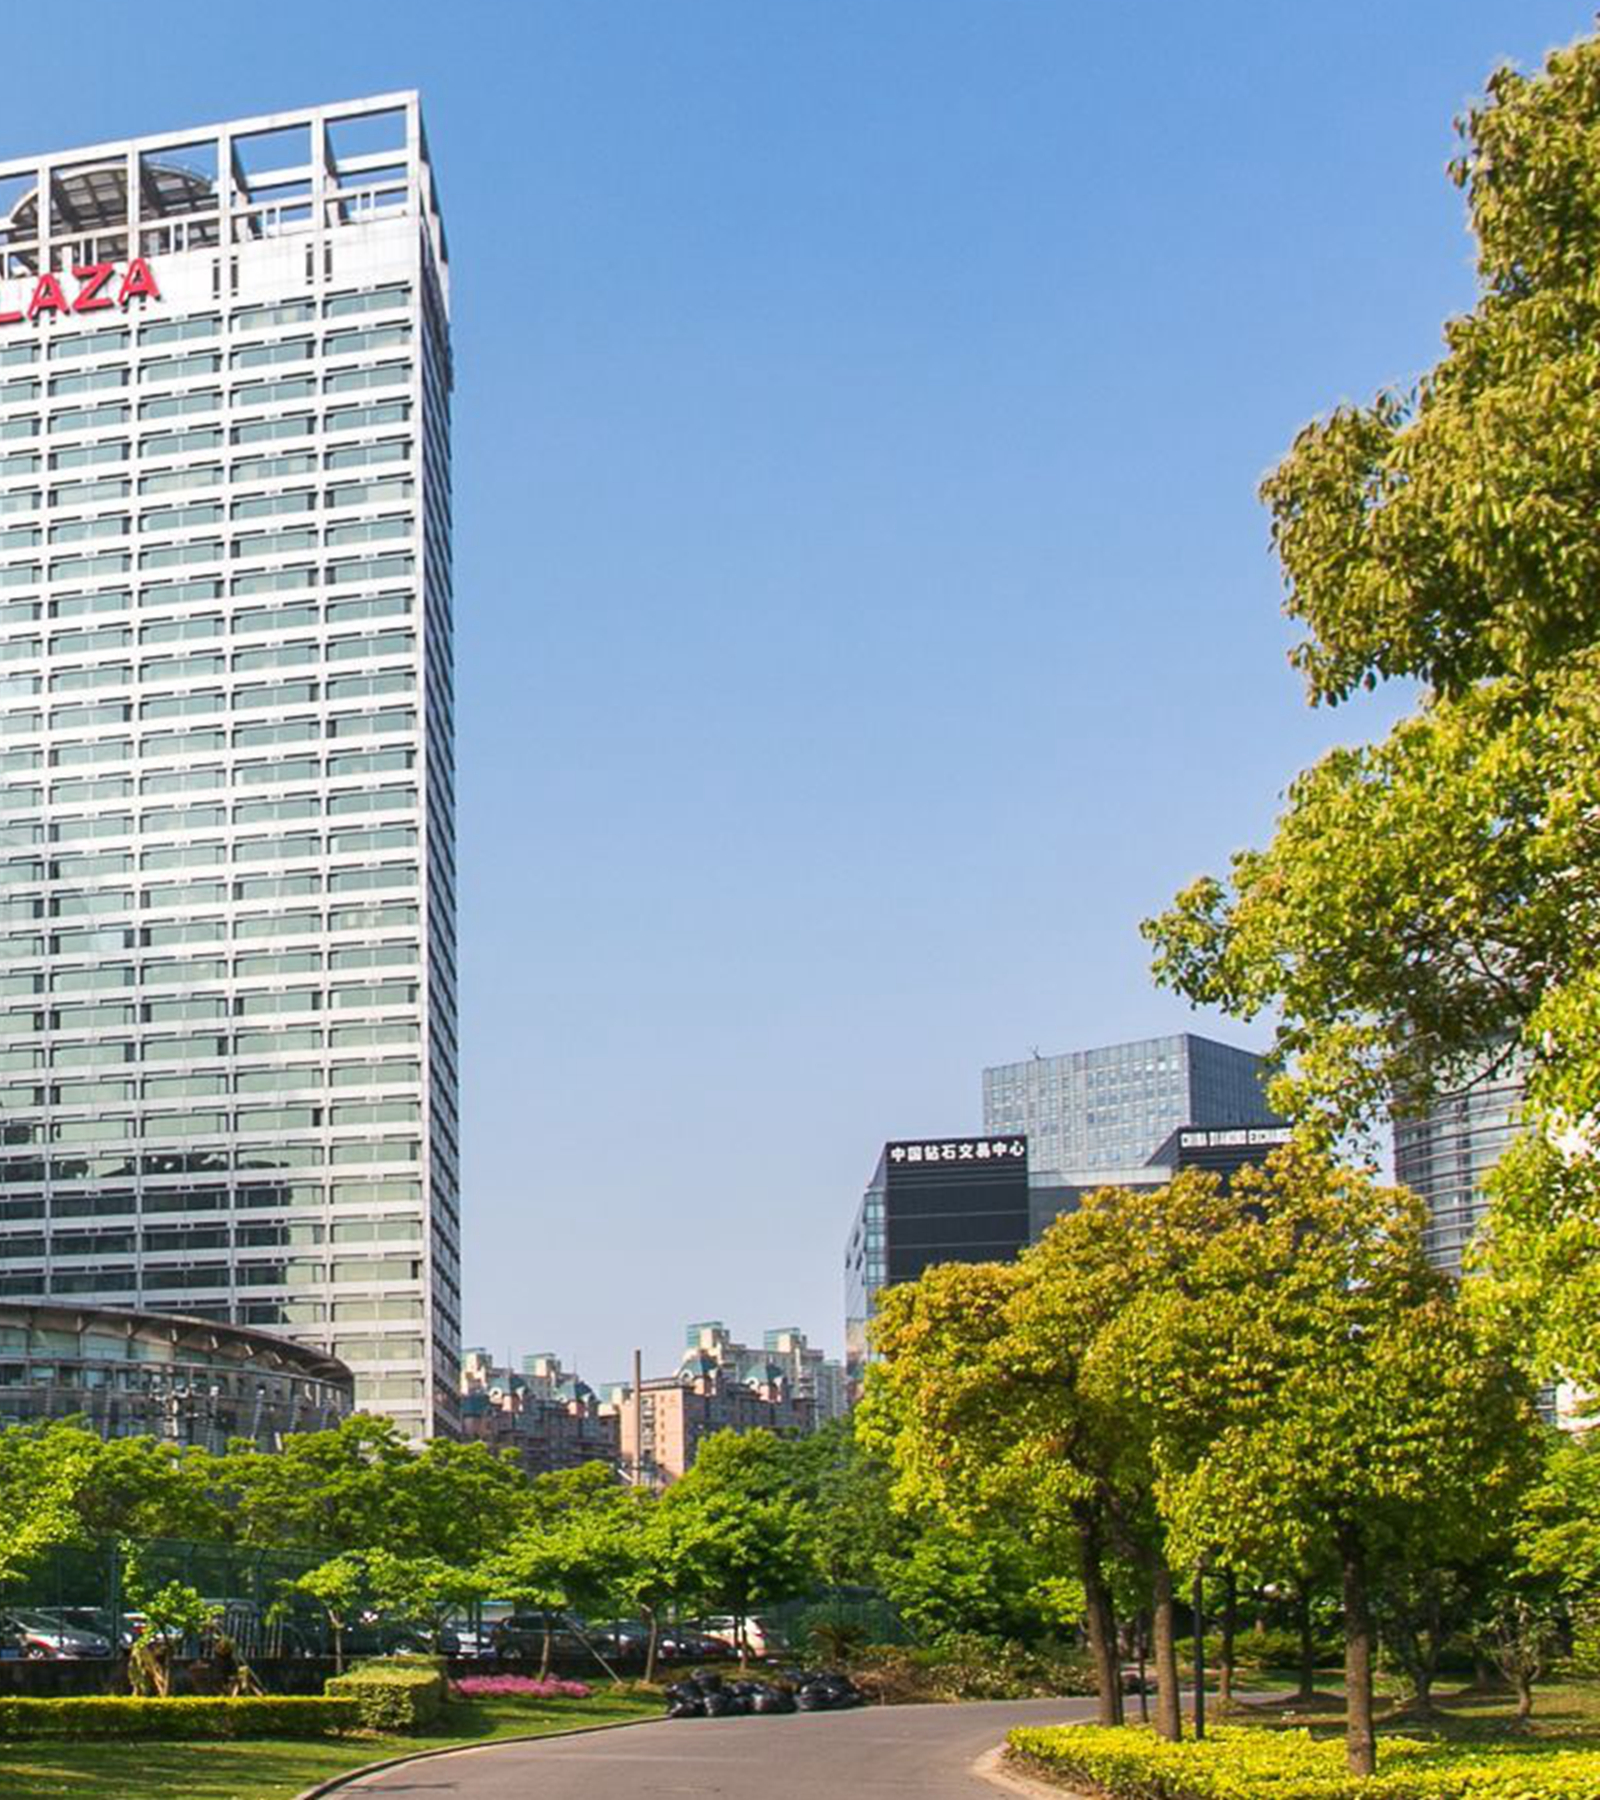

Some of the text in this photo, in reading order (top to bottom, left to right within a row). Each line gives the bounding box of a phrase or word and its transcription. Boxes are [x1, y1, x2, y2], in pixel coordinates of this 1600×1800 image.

[891, 1141, 1025, 1162] 中国钻石交易中心
